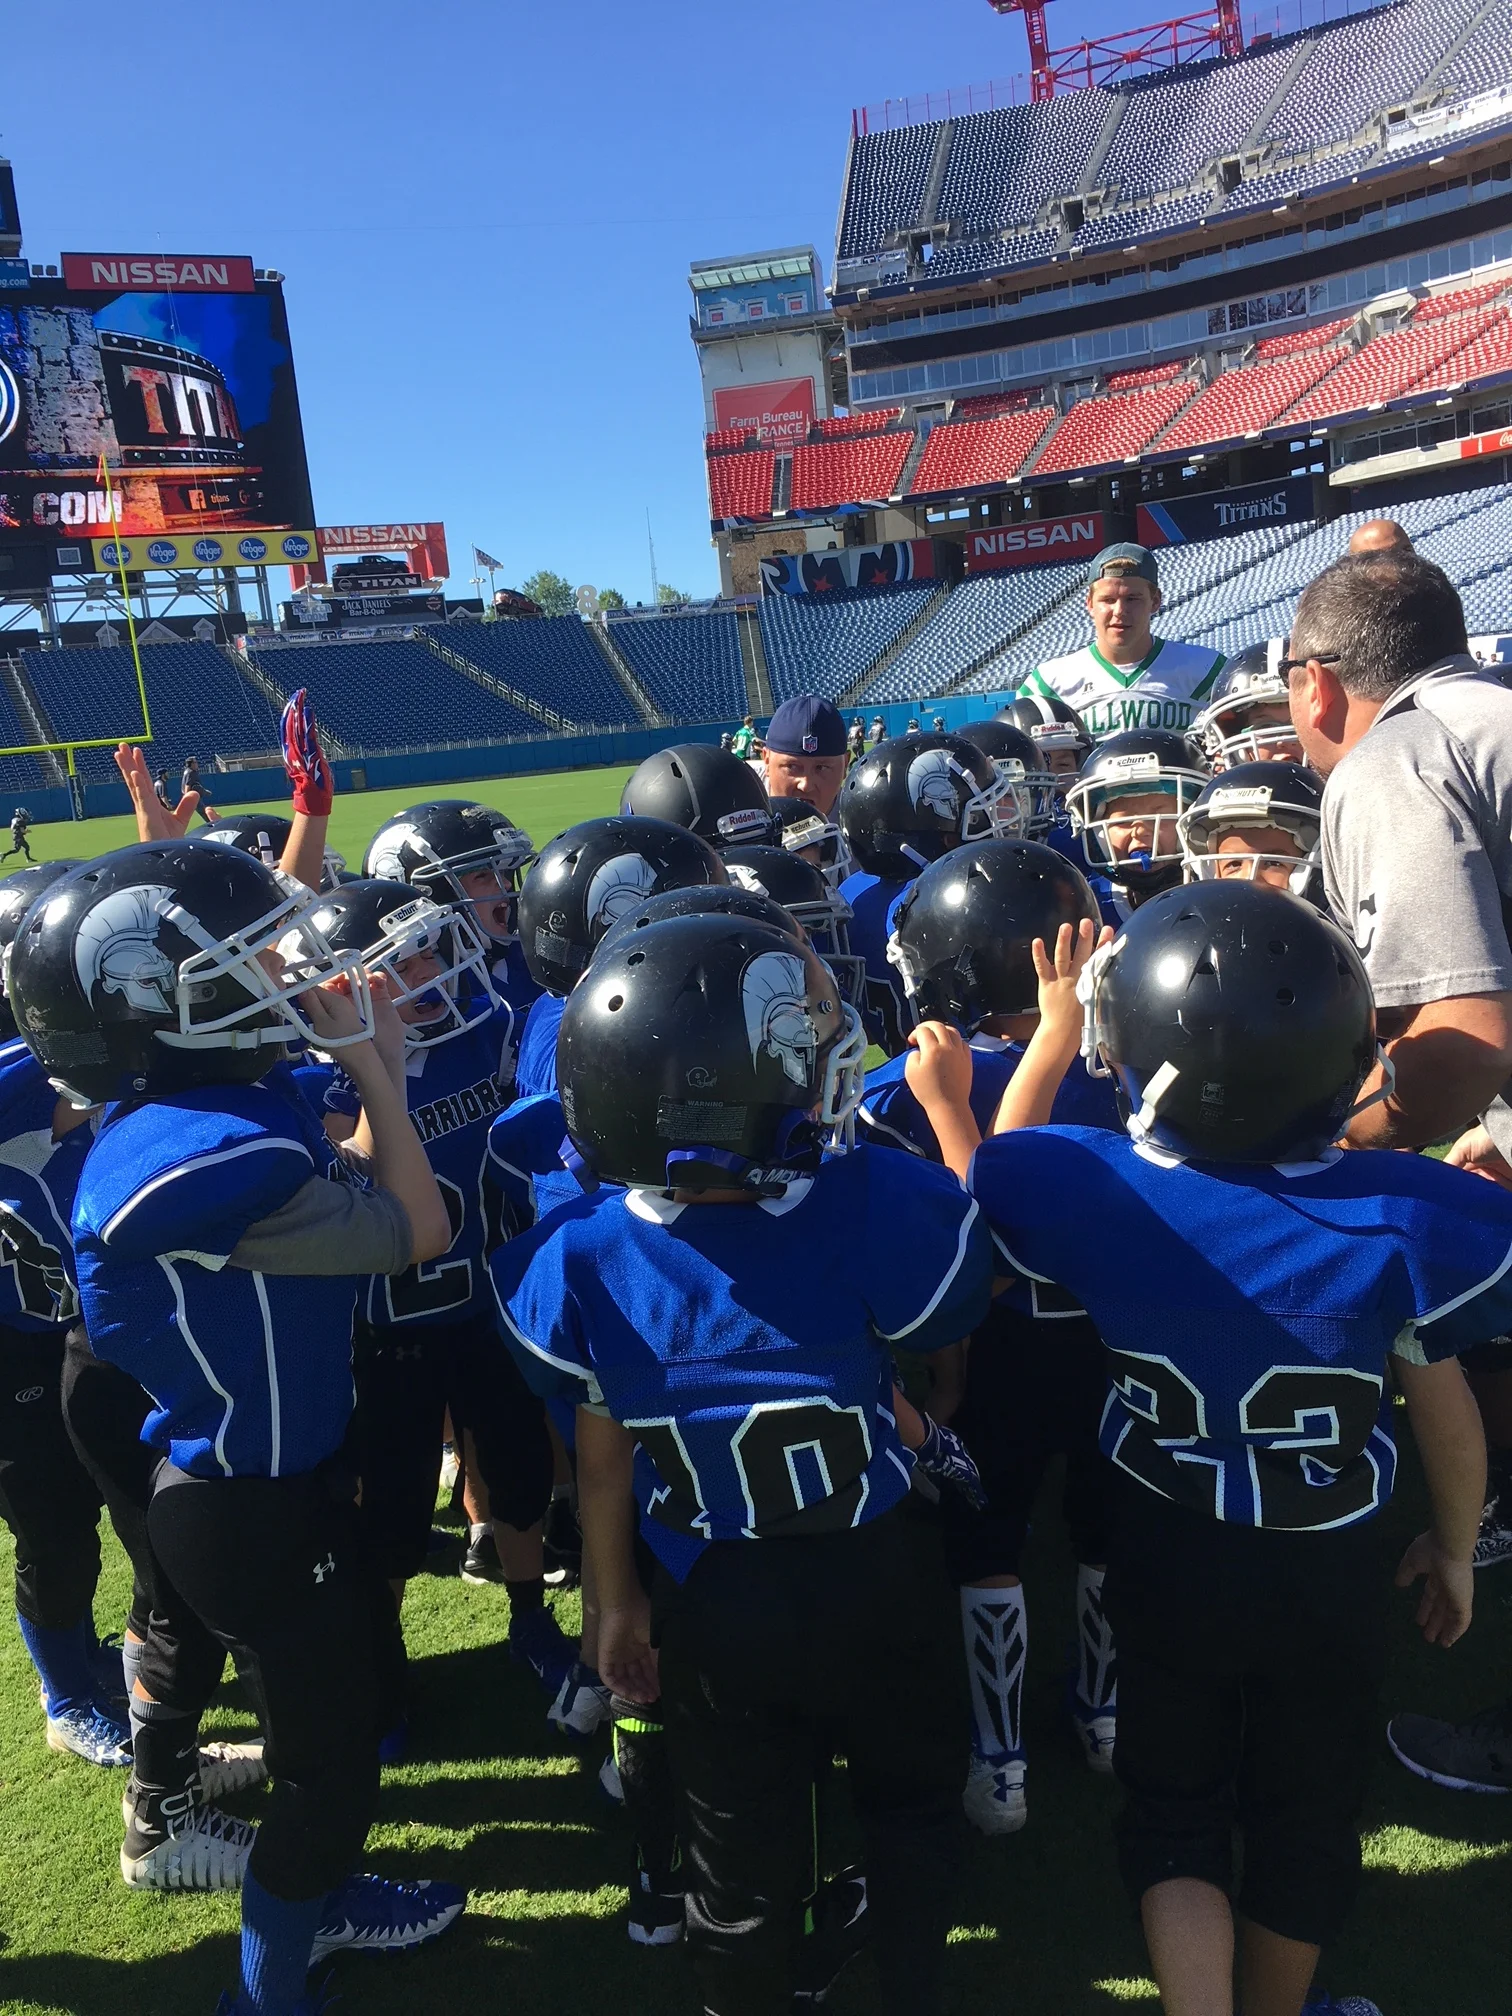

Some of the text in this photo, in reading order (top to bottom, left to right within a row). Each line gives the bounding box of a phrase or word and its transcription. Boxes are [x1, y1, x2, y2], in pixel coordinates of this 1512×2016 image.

[91, 262, 229, 285] NISSAN
[0, 279, 28, 288] g.com
[730, 411, 802, 428] Farm Bureau
[760, 422, 803, 437] RANCE
[33, 490, 122, 526] COM
[1213, 491, 1286, 527] TITANS
[323, 525, 427, 544] NISSAN
[974, 520, 1094, 556] NISSAN
[150, 544, 175, 562] Kroger
[195, 542, 220, 560] Kroger
[240, 540, 265, 558] Kroger
[284, 539, 309, 556] Kroger
[358, 577, 417, 588] TITAN
[342, 599, 391, 610] JACK DANIEL'S
[349, 608, 385, 617] Bar-B-Que
[301, 613, 327, 622] ROOM
[1083, 700, 1191, 732] ILLWOOD
[729, 811, 756, 825] Riddell
[408, 1072, 504, 1145] RRIOR
[687, 1100, 723, 1108] WARNING
